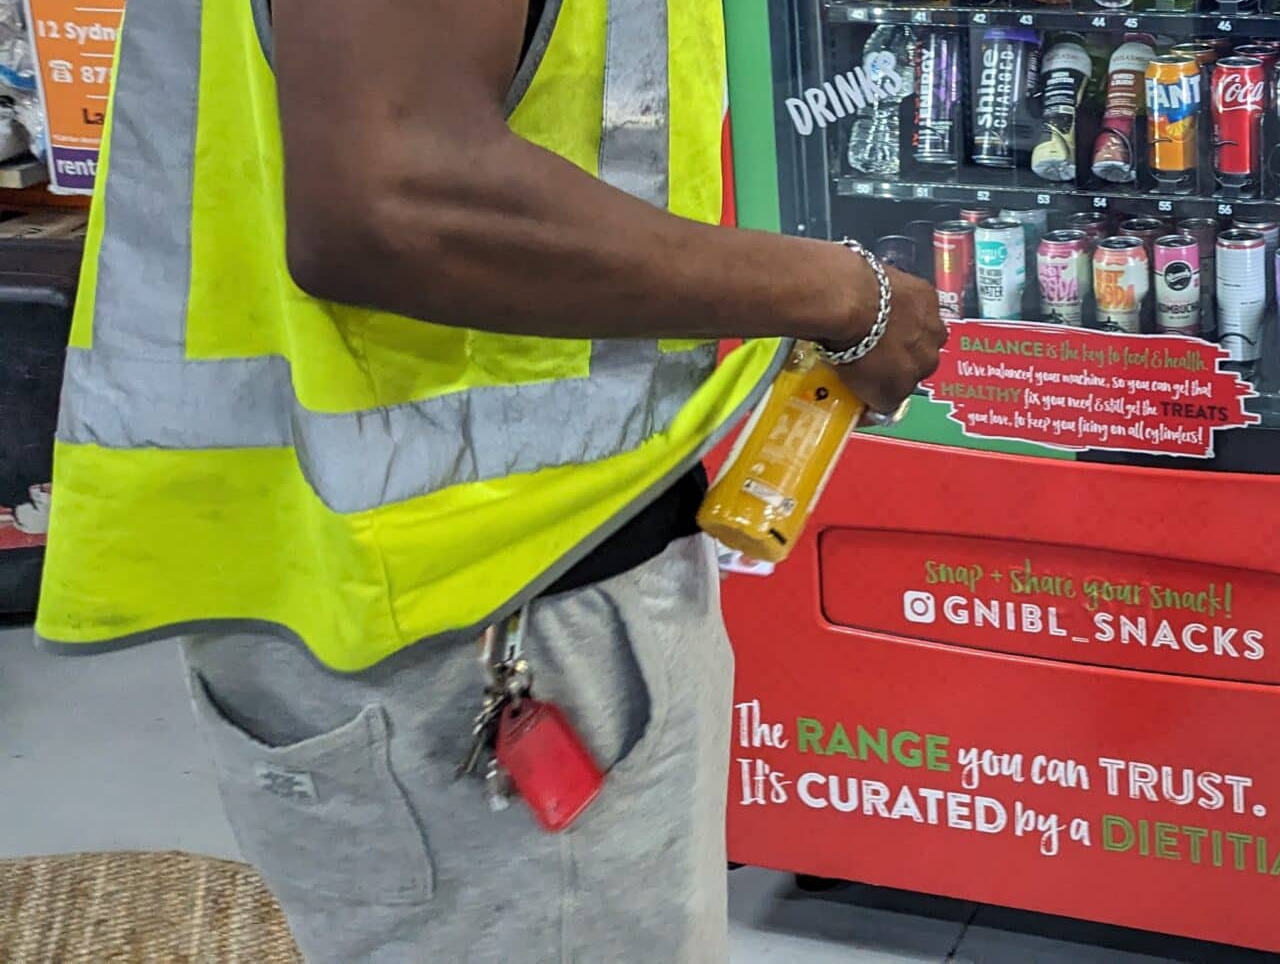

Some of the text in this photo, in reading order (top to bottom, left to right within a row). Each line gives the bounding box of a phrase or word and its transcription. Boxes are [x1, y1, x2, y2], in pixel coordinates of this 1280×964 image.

[973, 13, 987, 24] 42
[1019, 14, 1033, 25] 43
[1091, 16, 1106, 27] 44
[1124, 17, 1139, 28] 45
[37, 20, 61, 39] 12
[1217, 21, 1232, 32] 46
[785, 50, 903, 136] DRINKS
[916, 187, 929, 197] 51
[977, 191, 991, 201] 52
[1037, 194, 1051, 204] 53
[1093, 197, 1107, 207] 54
[1158, 201, 1172, 211] 55
[1218, 204, 1233, 215] 56
[959, 335, 1164, 371] BALANCE is the key to food &
[957, 360, 987, 377] We've
[987, 362, 1034, 383] balanced
[1034, 370, 1061, 386] your
[1126, 379, 1151, 394] you
[1151, 380, 1172, 393] can
[1171, 380, 1190, 400] get
[1190, 380, 1213, 398] that
[940, 382, 1229, 422] HEALTHY fix you need & still get the TREATS
[967, 410, 1204, 444] you to keep you firing on all cylinders!
[924, 558, 1234, 619] snap share your snack!
[943, 594, 1266, 661] GNIBL_SNACKS
[735, 699, 1267, 819] The RANGE you can TRUST.
[736, 756, 790, 807] It's
[797, 771, 1008, 837] CURATED
[1014, 804, 1067, 857] by
[1069, 819, 1092, 848] a
